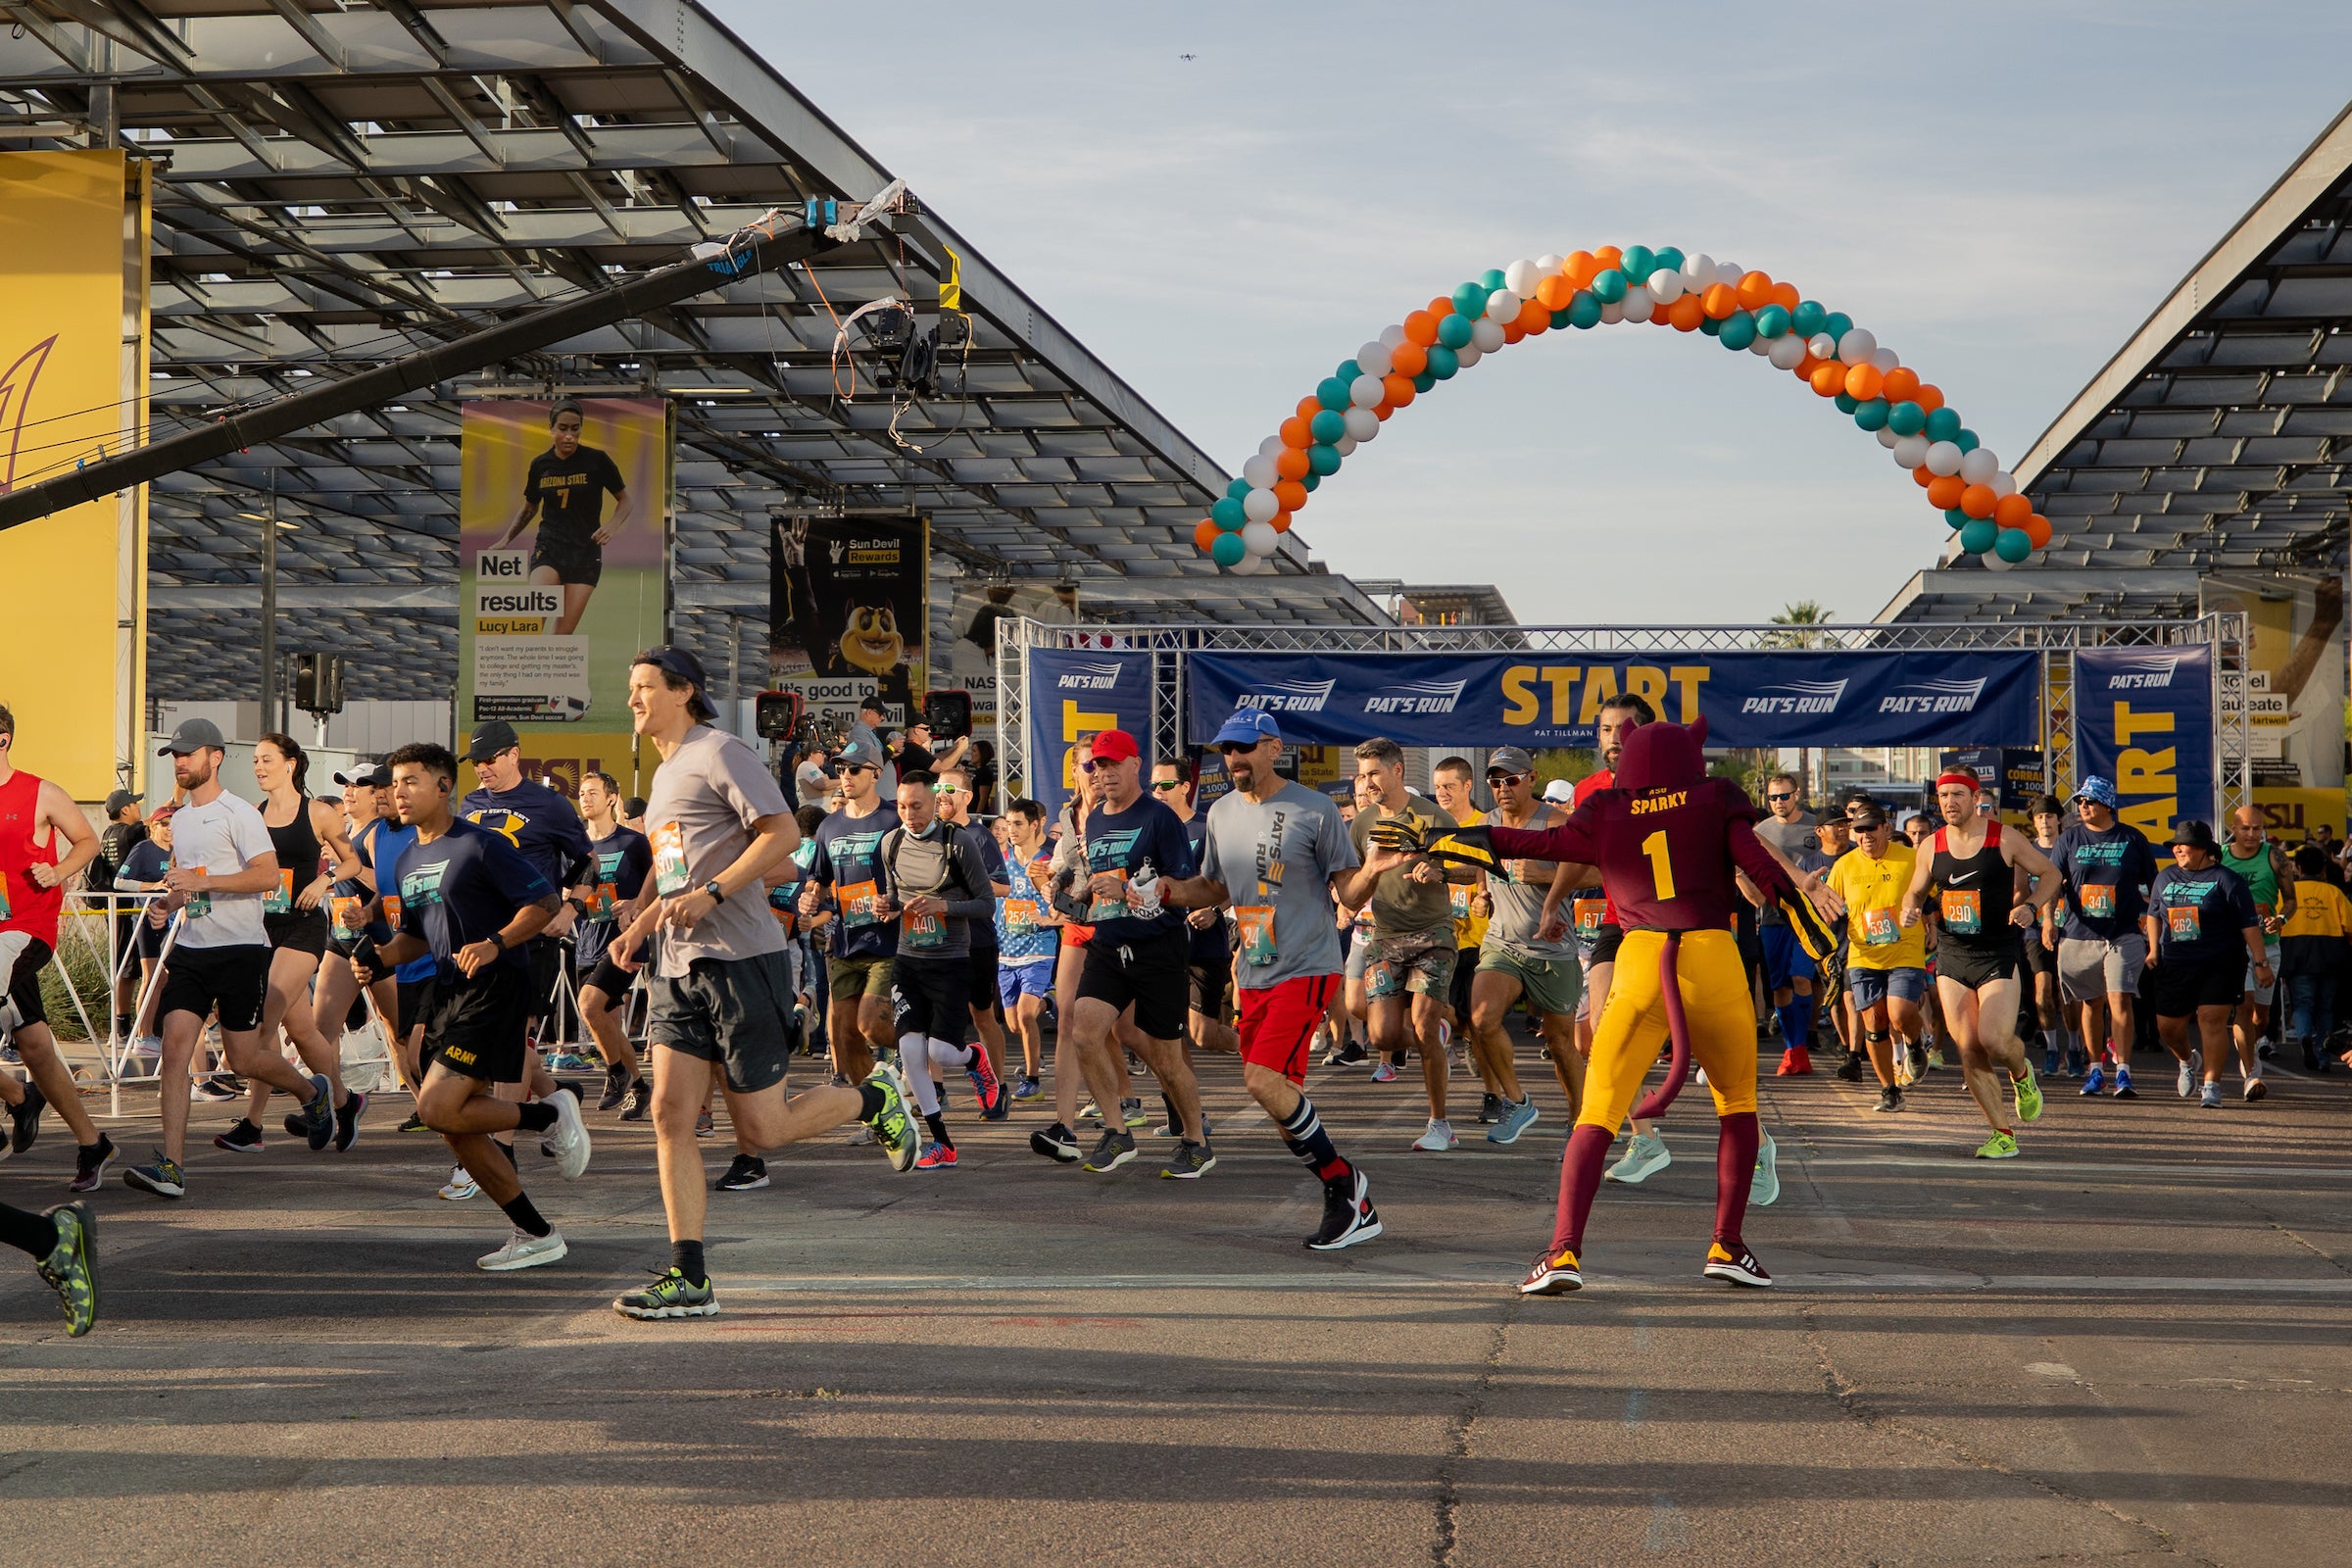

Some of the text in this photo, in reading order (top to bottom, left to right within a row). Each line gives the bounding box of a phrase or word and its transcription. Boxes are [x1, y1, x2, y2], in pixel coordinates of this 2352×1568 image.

[707, 249, 753, 275] TRIAGLE
[540, 472, 588, 489] ARIZONA STATE
[557, 488, 569, 509] 7
[850, 538, 900, 549] Sun Devil
[481, 556, 521, 575] Net
[851, 552, 898, 562] Rewards
[480, 591, 558, 612] results
[479, 620, 538, 634] Lucy Lara
[1058, 674, 1119, 690] PAT'S RUN
[2109, 673, 2171, 690] PAT'S RUN
[808, 682, 853, 700] good
[858, 684, 875, 697] to
[1500, 665, 1710, 725] START
[1235, 694, 1324, 711] PAT'S RUN
[1364, 697, 1455, 712] PAT'S RUN
[1741, 697, 1837, 713] PAT'S RUN
[1879, 696, 1976, 712] PAT'S RUN
[2007, 770, 2044, 781] CORRAL
[1206, 783, 1229, 793] 1000
[1631, 791, 1688, 815] SPARKY
[1269, 810, 1285, 859] PAT'S
[1256, 844, 1268, 882] RUN
[1642, 829, 1676, 901] 1
[850, 896, 872, 914] 495
[2088, 896, 2108, 909] 341
[1949, 906, 1972, 922] 290
[912, 915, 936, 934] 440
[1870, 918, 1892, 937] 533
[2174, 918, 2192, 933] 262
[1244, 926, 1260, 949] 24
[445, 1045, 477, 1065] ARMY
